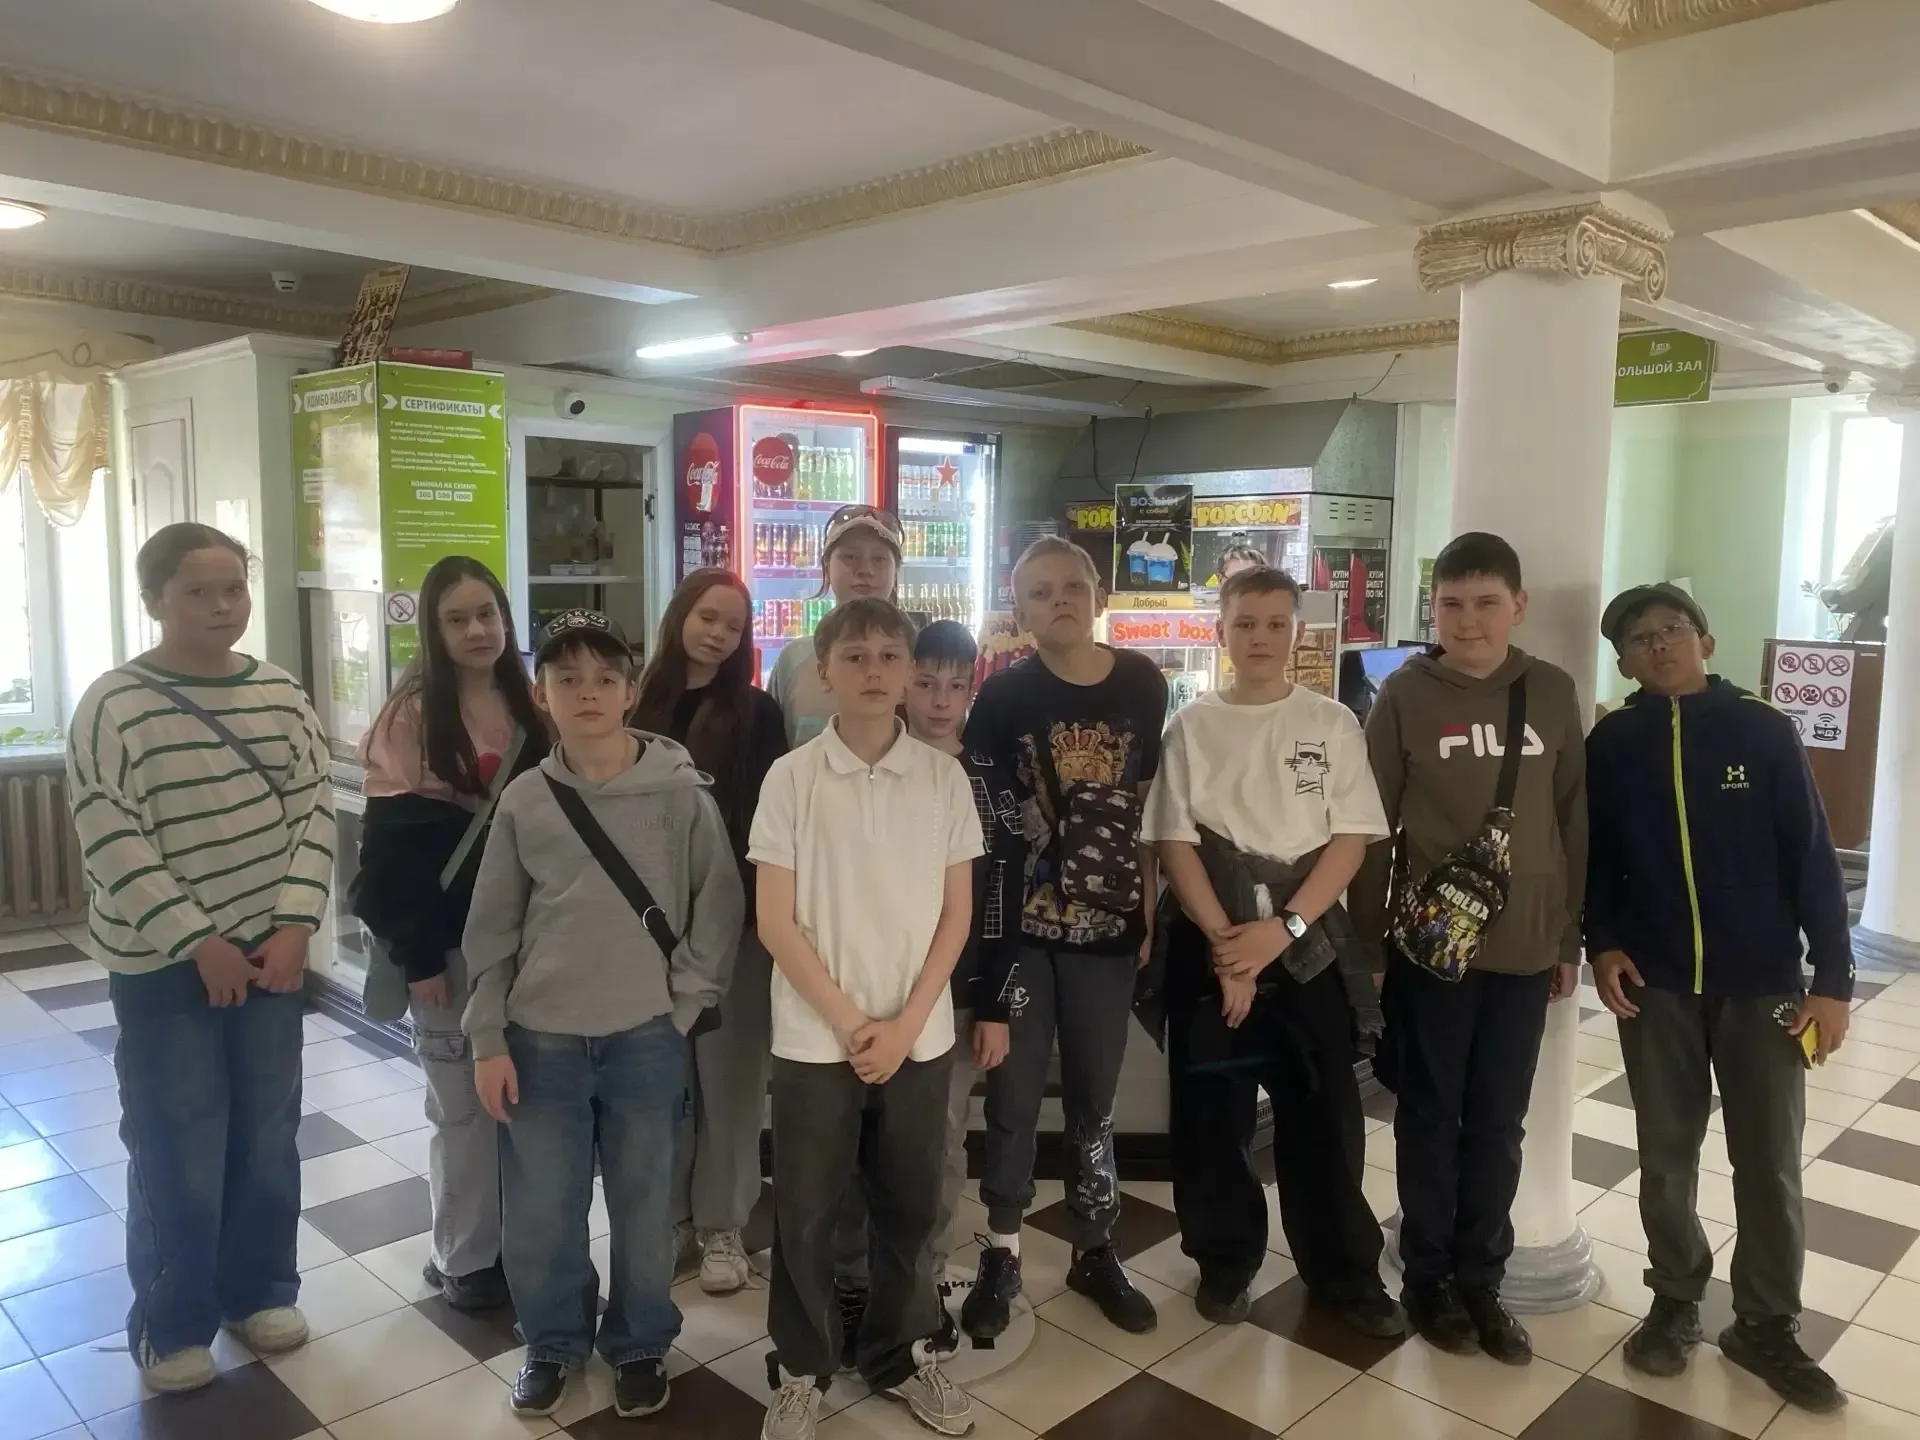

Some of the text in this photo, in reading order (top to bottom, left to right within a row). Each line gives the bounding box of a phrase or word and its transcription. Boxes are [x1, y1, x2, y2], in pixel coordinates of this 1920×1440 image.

[1615, 360, 1702, 377] ОЛЬШОЙ ЗАЛ
[307, 393, 329, 408] КОМБО
[405, 398, 482, 415] СЕРТИФИКАТЫ
[1196, 503, 1289, 527] POPCORN
[1332, 570, 1349, 579] КУПИ
[1368, 570, 1384, 579] КУПИ
[1329, 580, 1349, 589] БИЛЕТ
[1366, 580, 1384, 589] БИЛЕТ
[1365, 590, 1375, 598] ПО
[1132, 597, 1168, 609] Добрый
[1113, 619, 1214, 641] Sweet box
[1439, 722, 1545, 759] FILA
